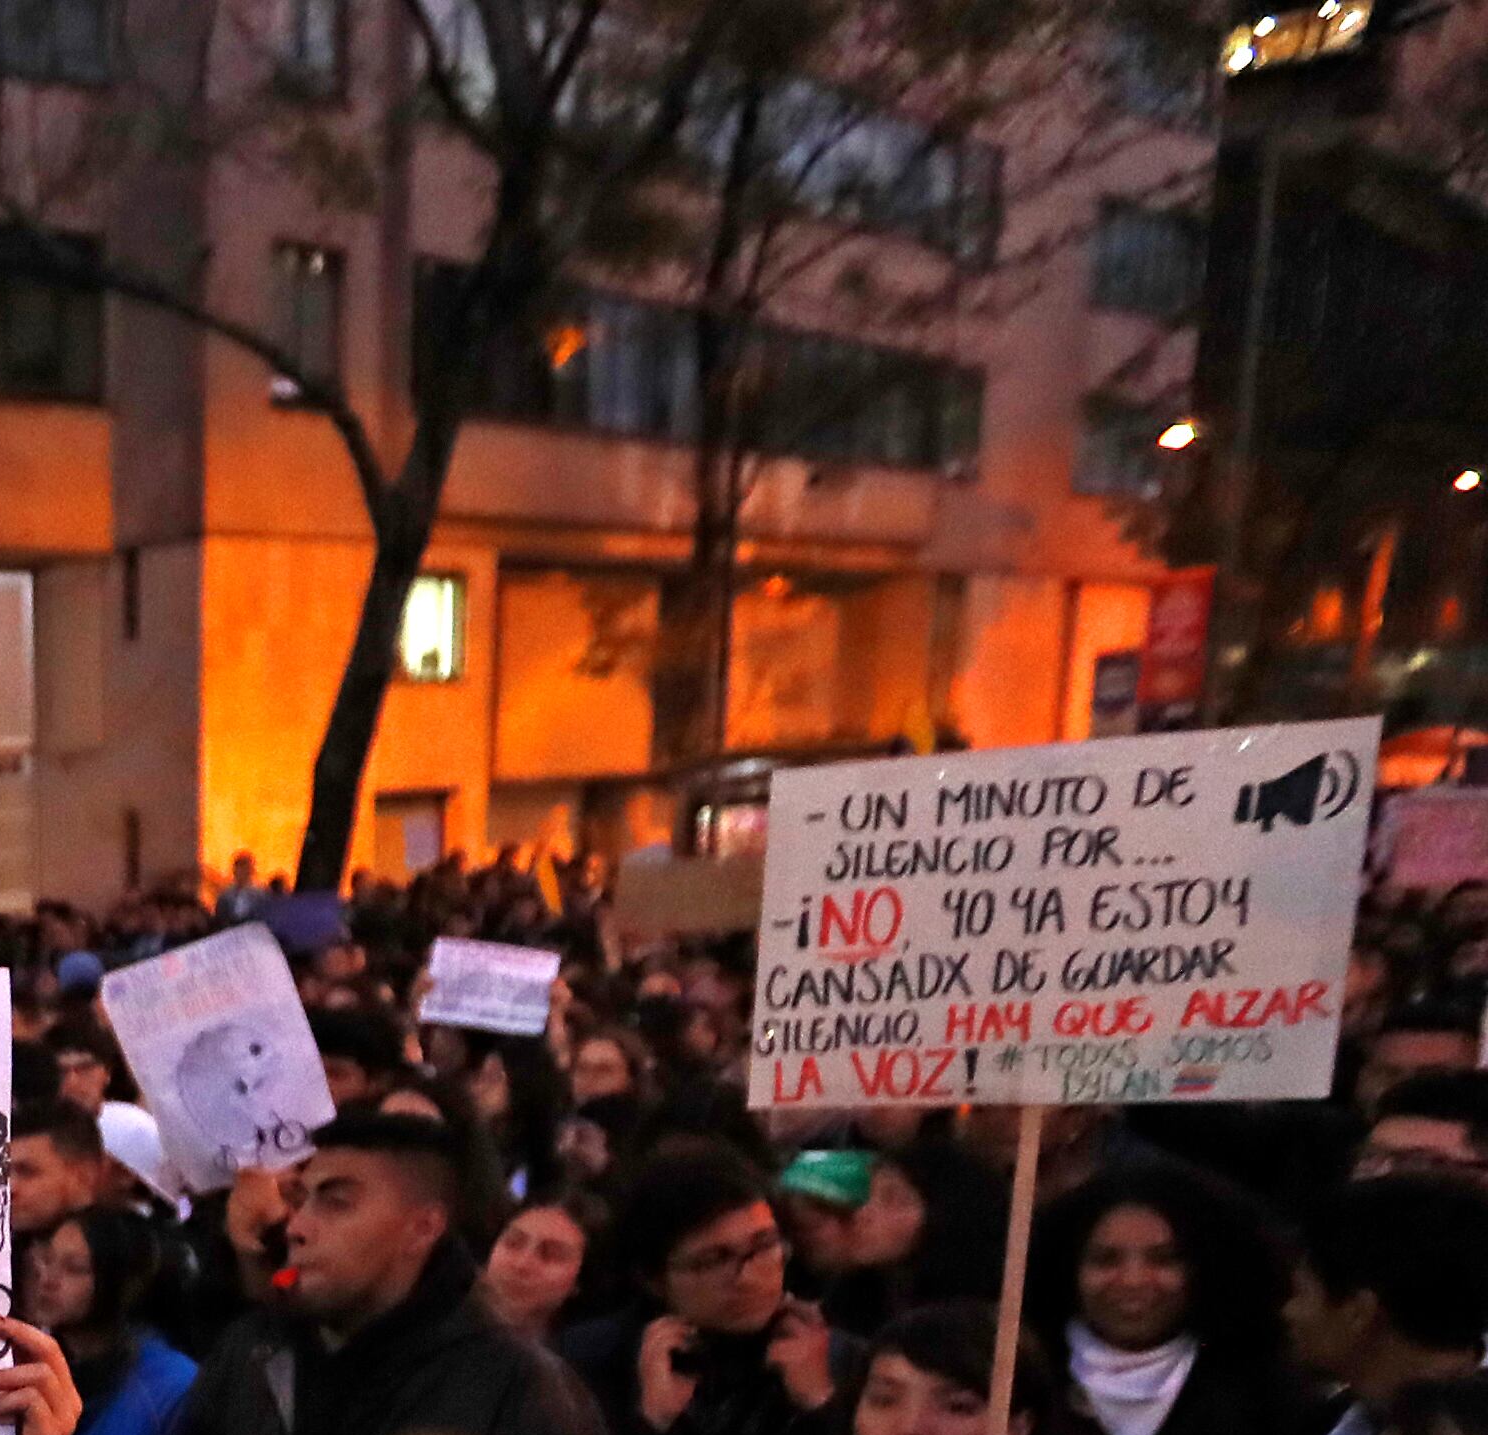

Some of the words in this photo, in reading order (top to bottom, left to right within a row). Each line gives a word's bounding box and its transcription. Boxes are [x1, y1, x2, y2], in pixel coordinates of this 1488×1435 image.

[937, 775, 1108, 825] MINUTO
[1133, 765, 1196, 808] DE
[826, 835, 1014, 880] SILENCIO
[1089, 877, 1251, 932] ESTOY
[766, 952, 973, 1010] CANSADX
[992, 949, 1047, 994] DE
[1062, 938, 1237, 992] GUARDAR
[945, 1002, 1031, 1043] HAY
[1053, 996, 1154, 1036] QUE
[1180, 979, 1330, 1029] ALZAR
[773, 1055, 824, 1104] LA
